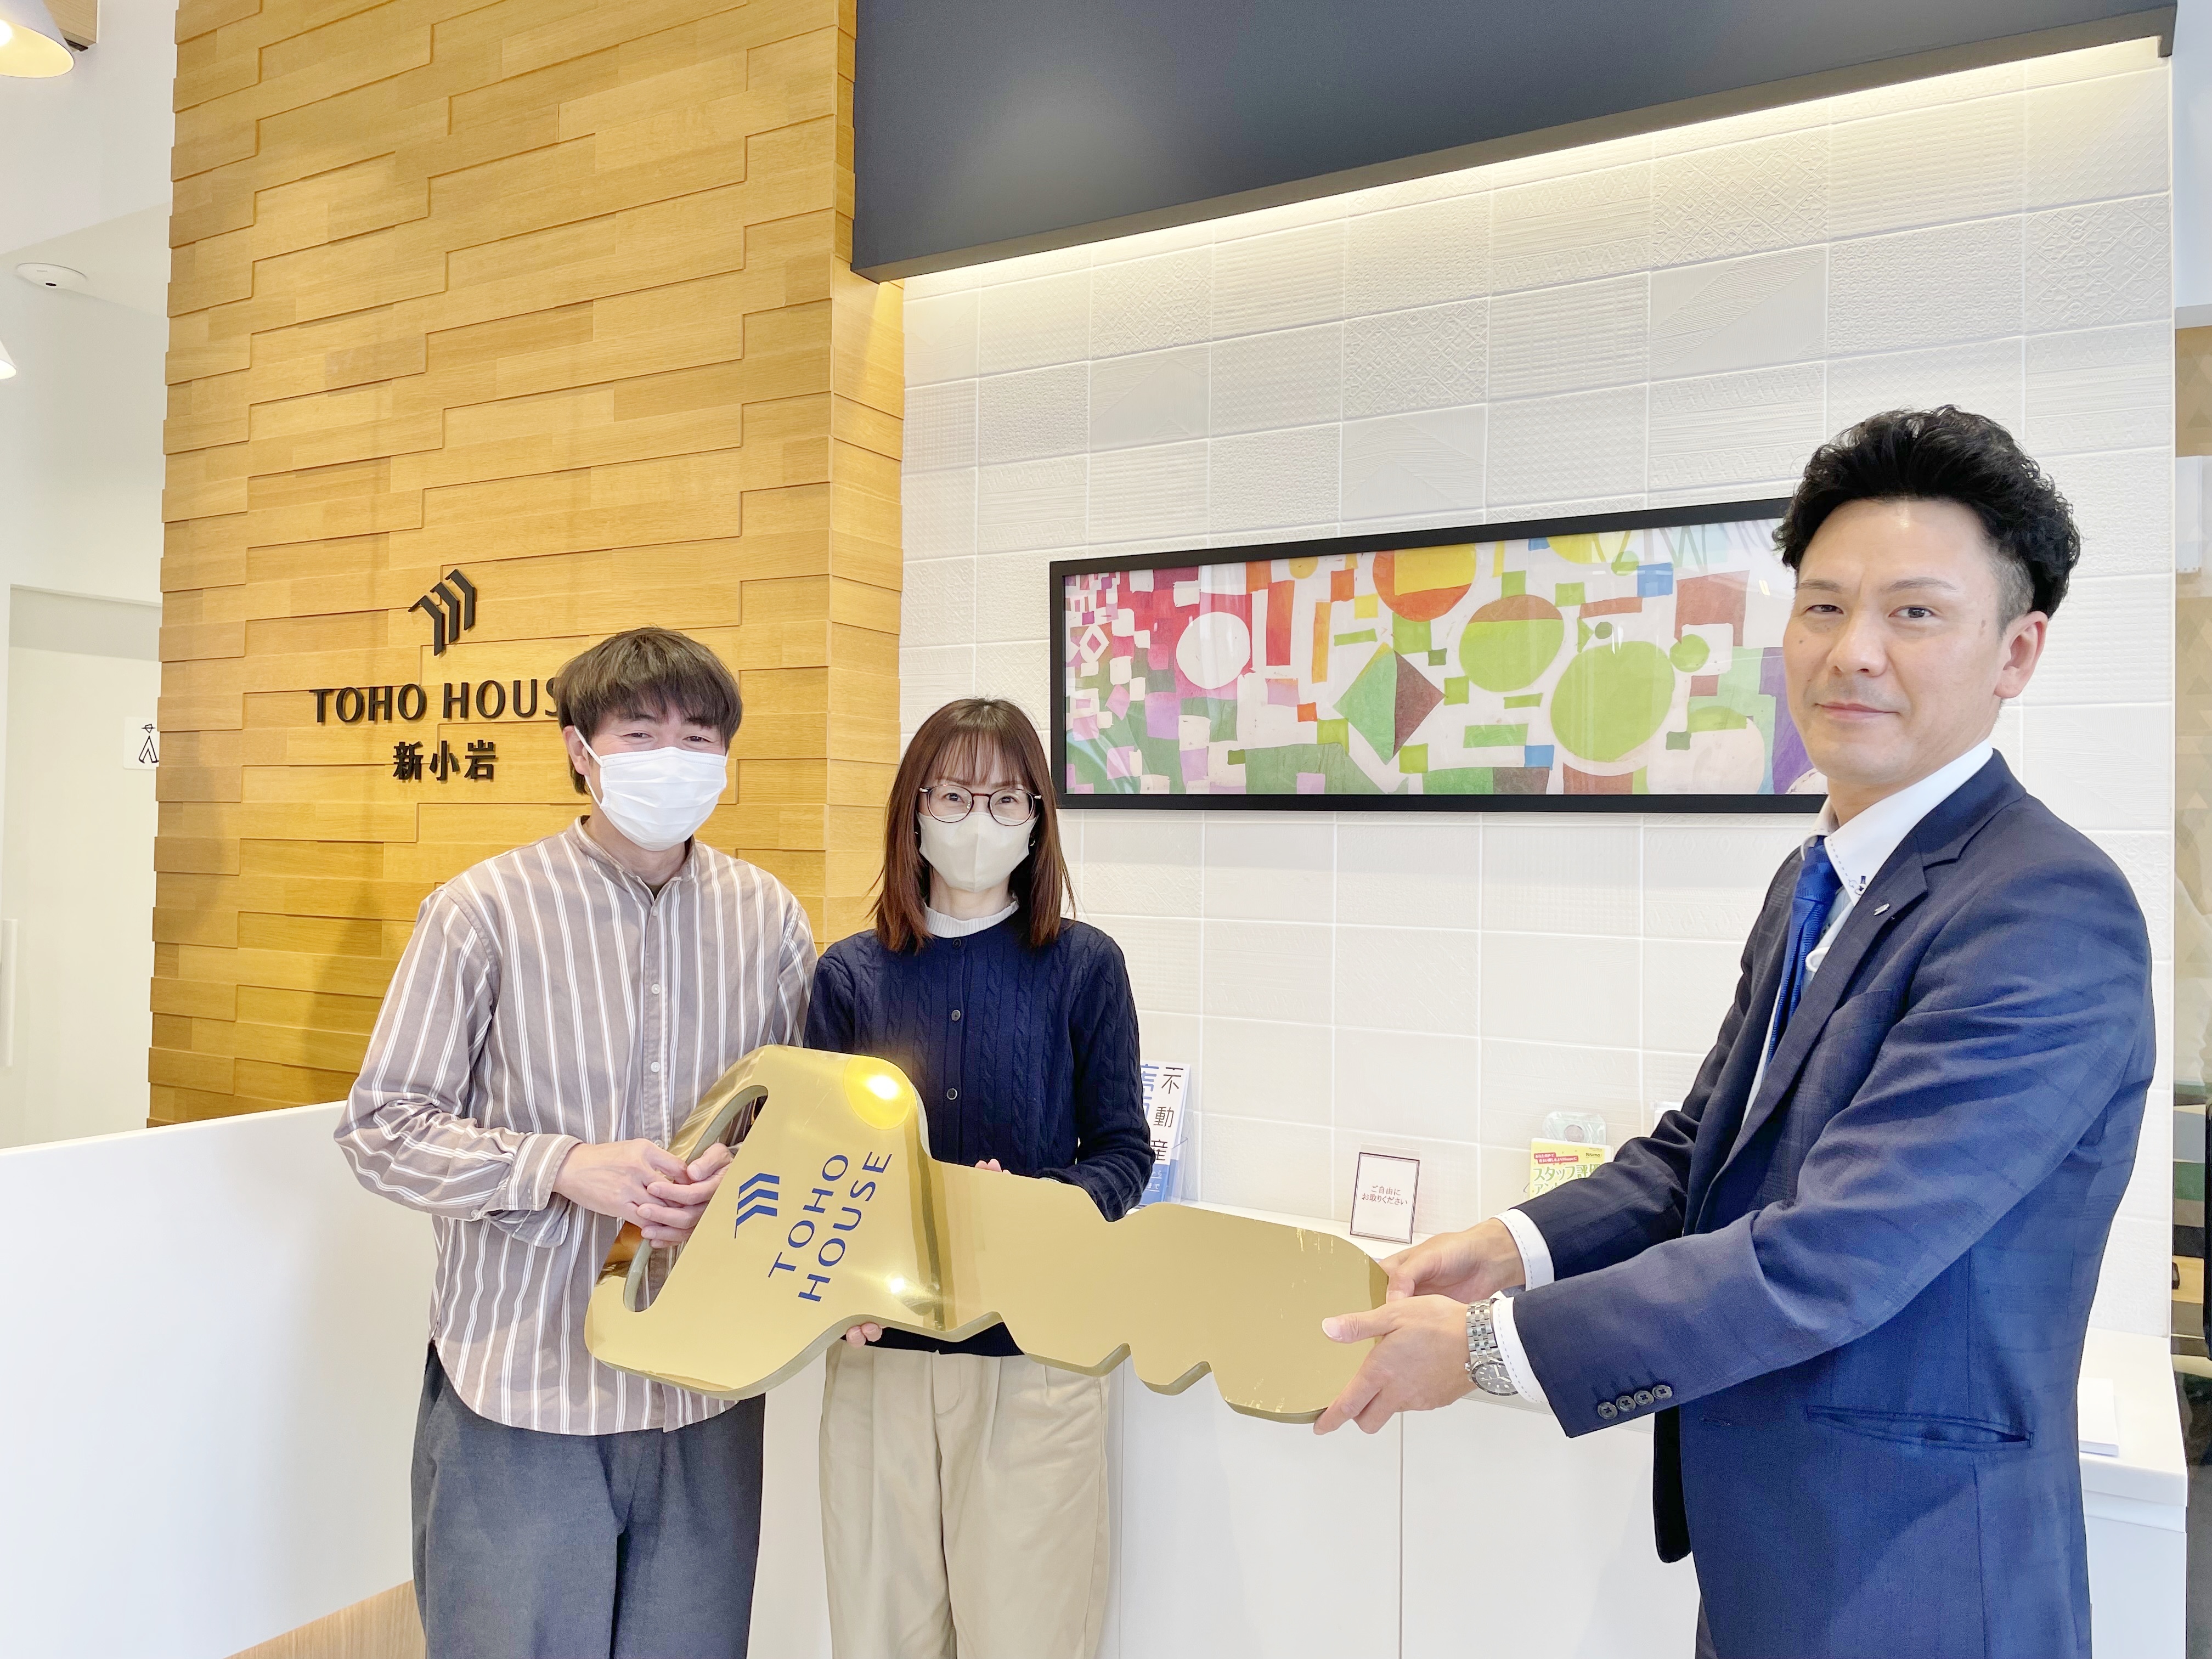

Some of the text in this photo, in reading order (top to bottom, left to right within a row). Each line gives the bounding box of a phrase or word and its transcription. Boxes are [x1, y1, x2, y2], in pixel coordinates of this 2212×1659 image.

[309, 684, 427, 723] TOHO
[392, 739, 496, 781] 新小岩
[1150, 1074, 1182, 1161] 不動産
[1361, 1193, 1408, 1206] お取りください
[1370, 1185, 1401, 1196] ご自由に
[768, 1154, 849, 1278] TOHO
[798, 1151, 893, 1302] HOUSE
